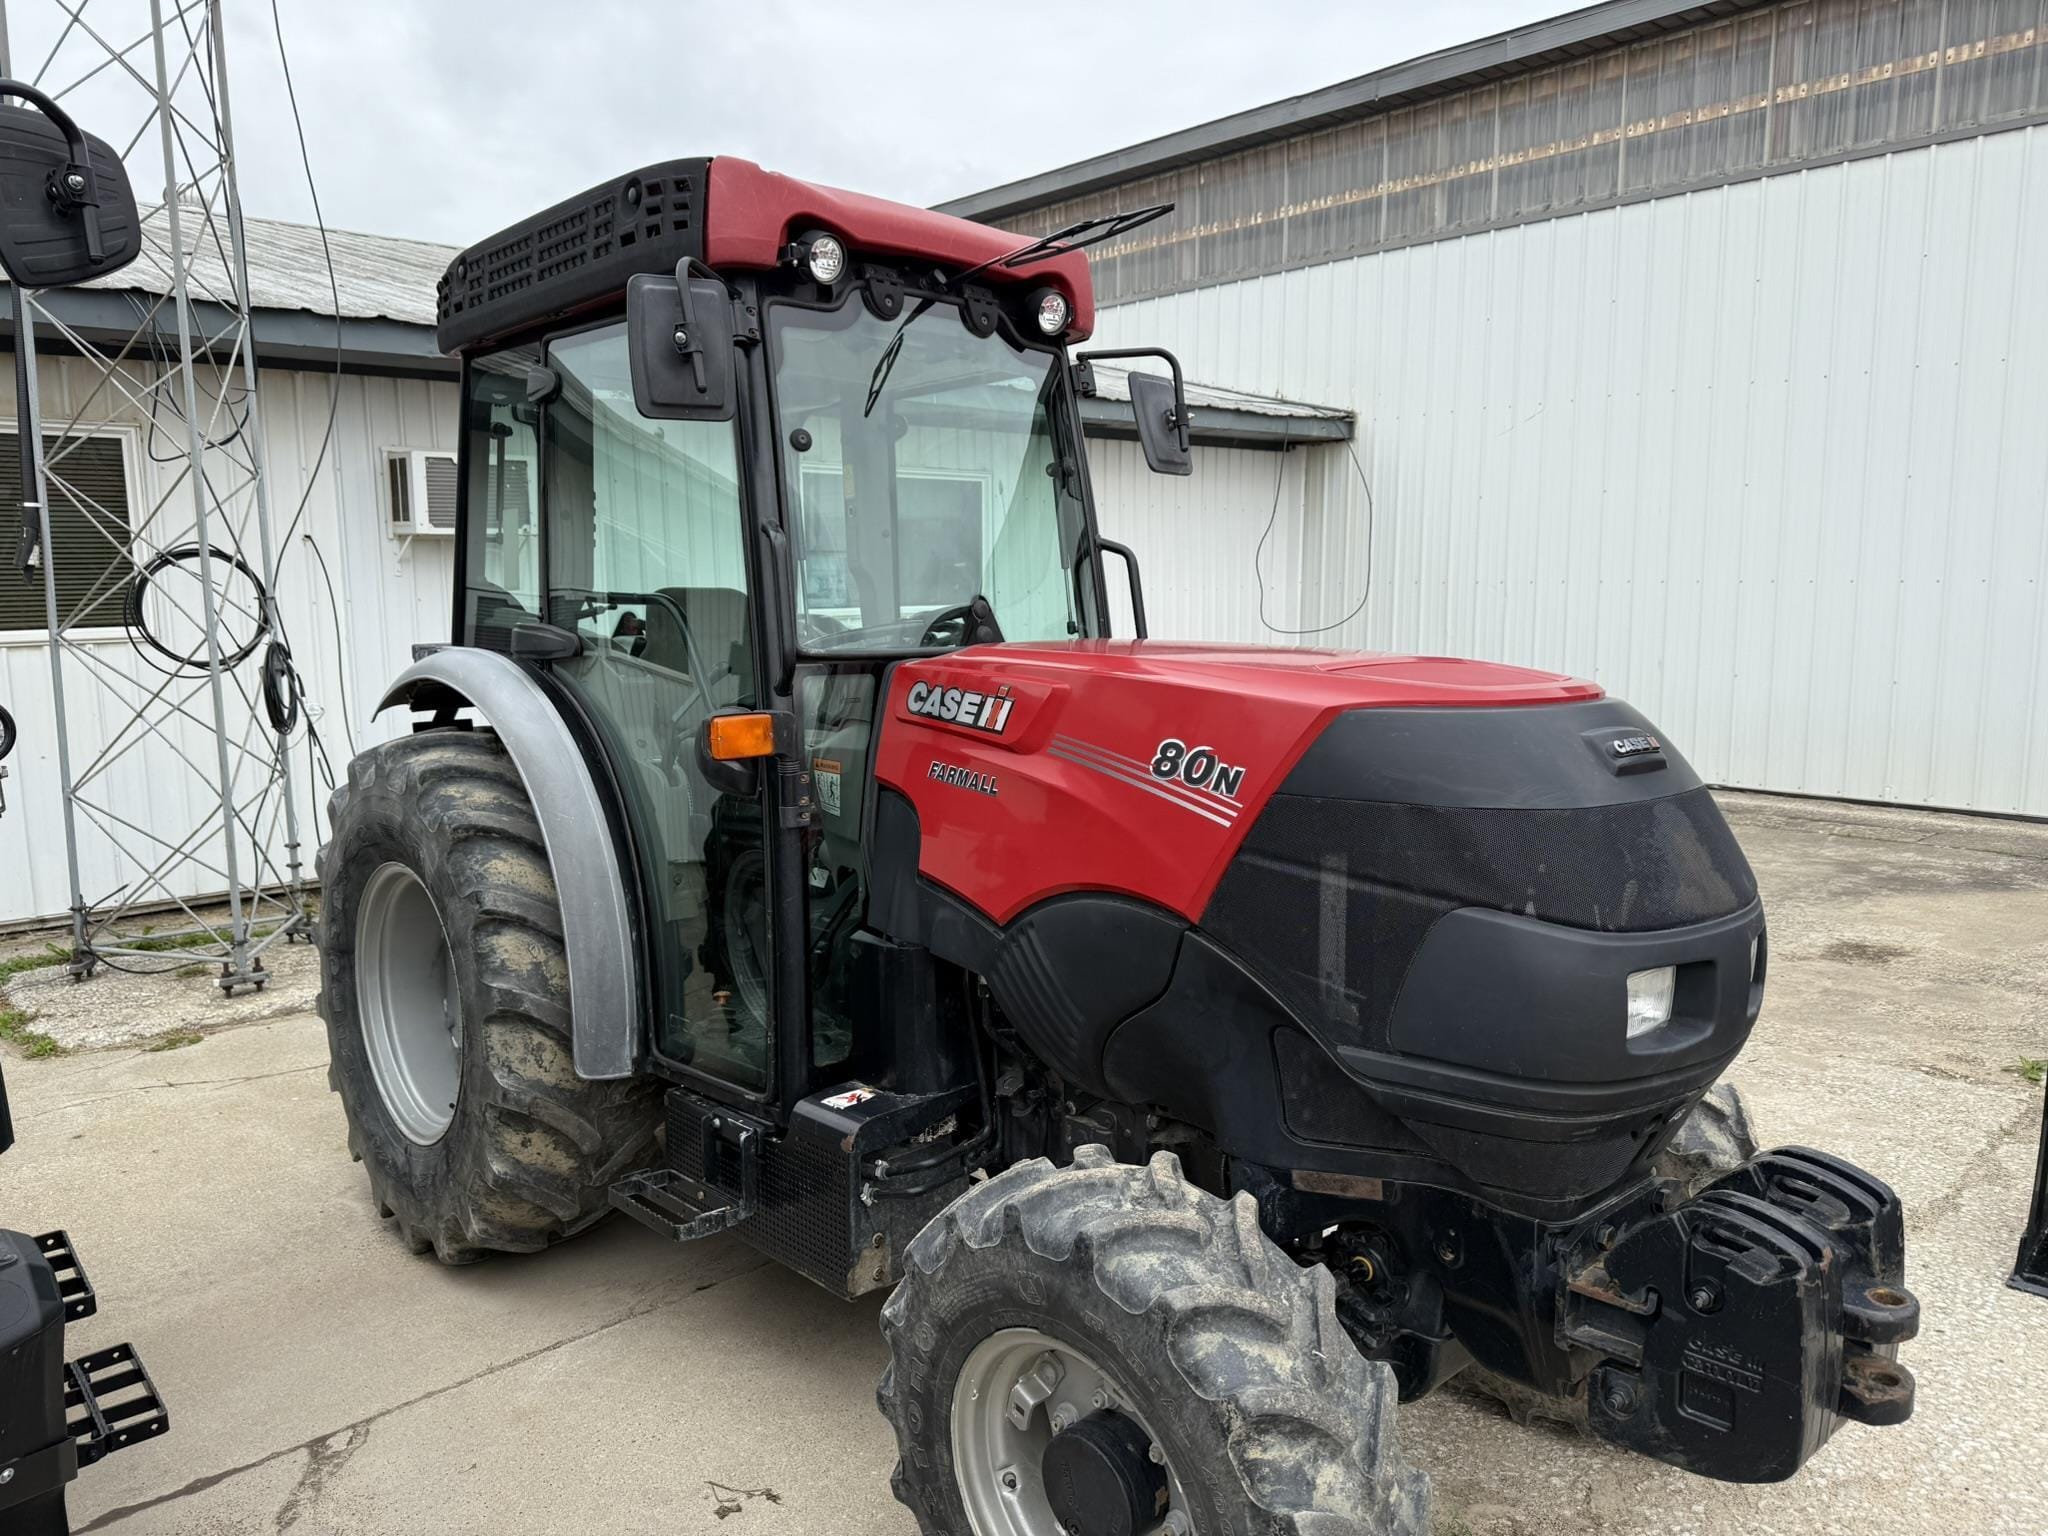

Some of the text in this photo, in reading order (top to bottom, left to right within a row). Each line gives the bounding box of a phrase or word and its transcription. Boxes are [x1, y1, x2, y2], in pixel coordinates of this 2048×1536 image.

[906, 681, 981, 725] CASE
[1613, 736, 1650, 753] CASE
[927, 760, 999, 797] FARMALL
